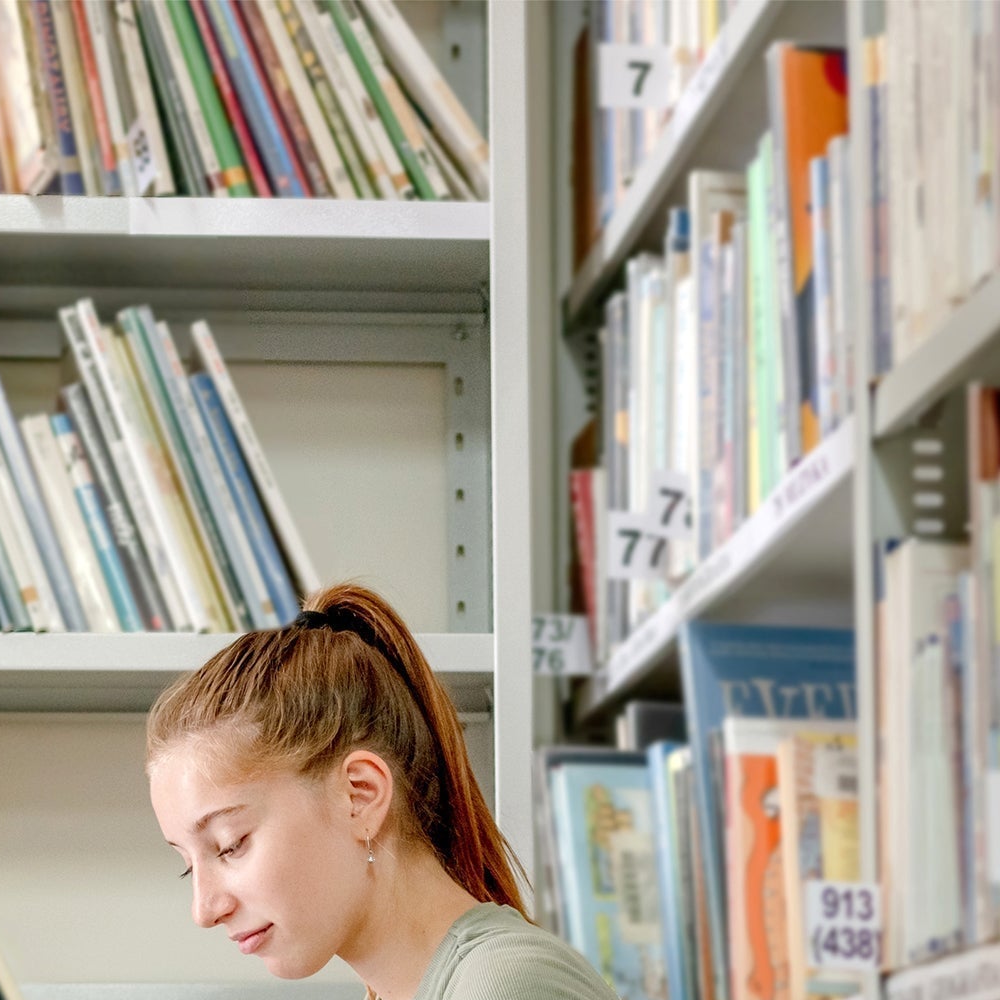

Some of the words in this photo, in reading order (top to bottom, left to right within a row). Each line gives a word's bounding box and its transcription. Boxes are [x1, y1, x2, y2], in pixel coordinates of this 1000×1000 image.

[627, 61, 653, 98] 7
[532, 647, 566, 672] 76
[821, 885, 874, 922] 913
[811, 924, 883, 967] (438)
